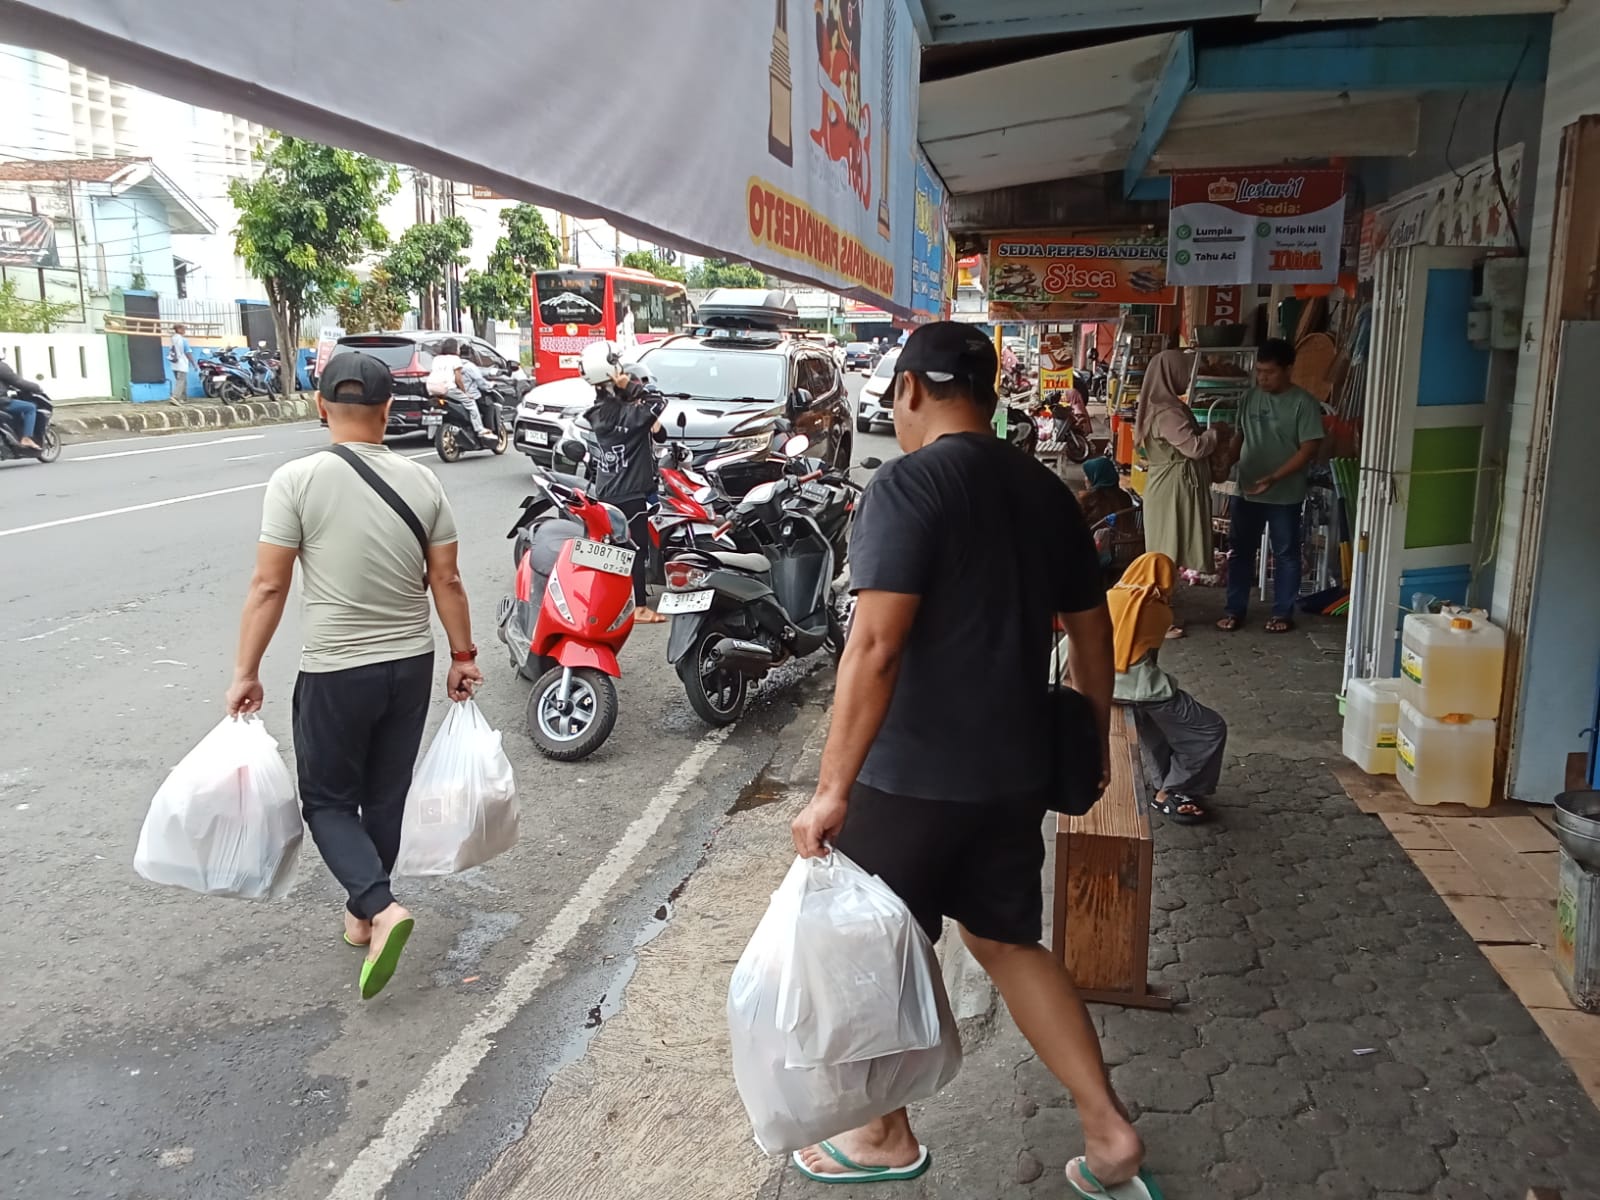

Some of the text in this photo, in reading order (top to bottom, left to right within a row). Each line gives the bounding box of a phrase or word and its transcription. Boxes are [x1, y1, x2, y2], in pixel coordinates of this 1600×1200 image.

[1257, 202, 1301, 215] Sedia:
[1195, 226, 1233, 237] Lumpia
[1275, 224, 1327, 236] Kripik Niti
[999, 243, 1168, 260] SEDIA PEPES BANDENG
[1195, 251, 1237, 261] Tahu Aci
[1043, 263, 1117, 294] Sisca
[575, 540, 582, 551] B
[586, 543, 612, 559] 3087
